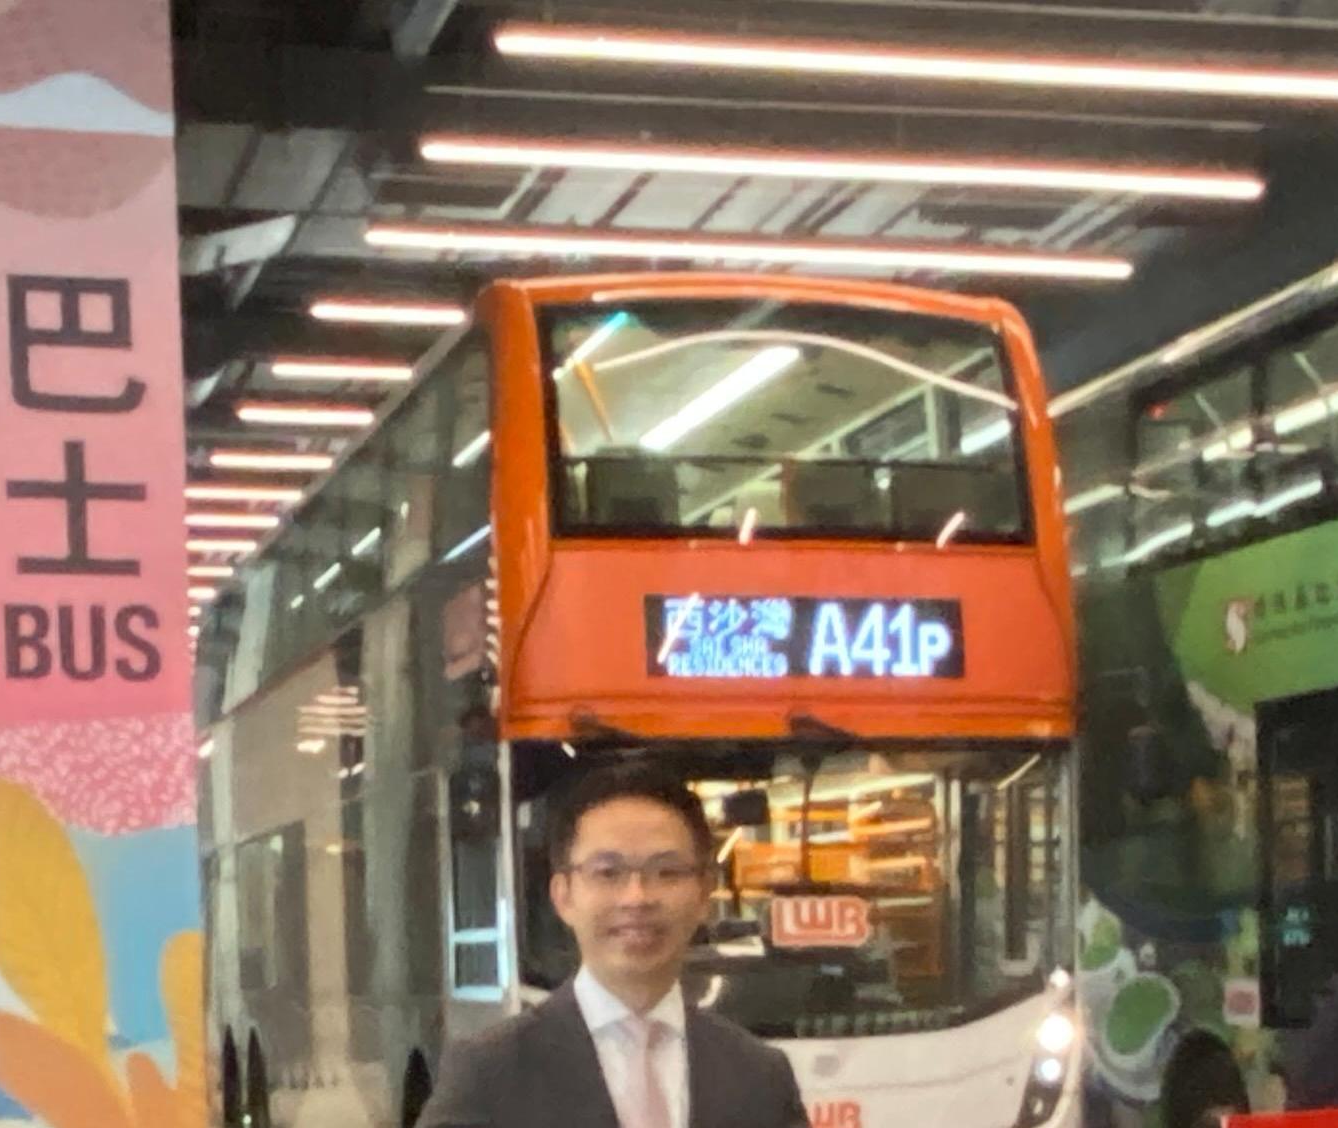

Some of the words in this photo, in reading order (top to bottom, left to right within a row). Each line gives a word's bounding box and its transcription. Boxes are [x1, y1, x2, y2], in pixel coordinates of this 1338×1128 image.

[4, 272, 149, 577] 巴士
[2, 603, 161, 683] BUS
[809, 601, 952, 677] A41P
